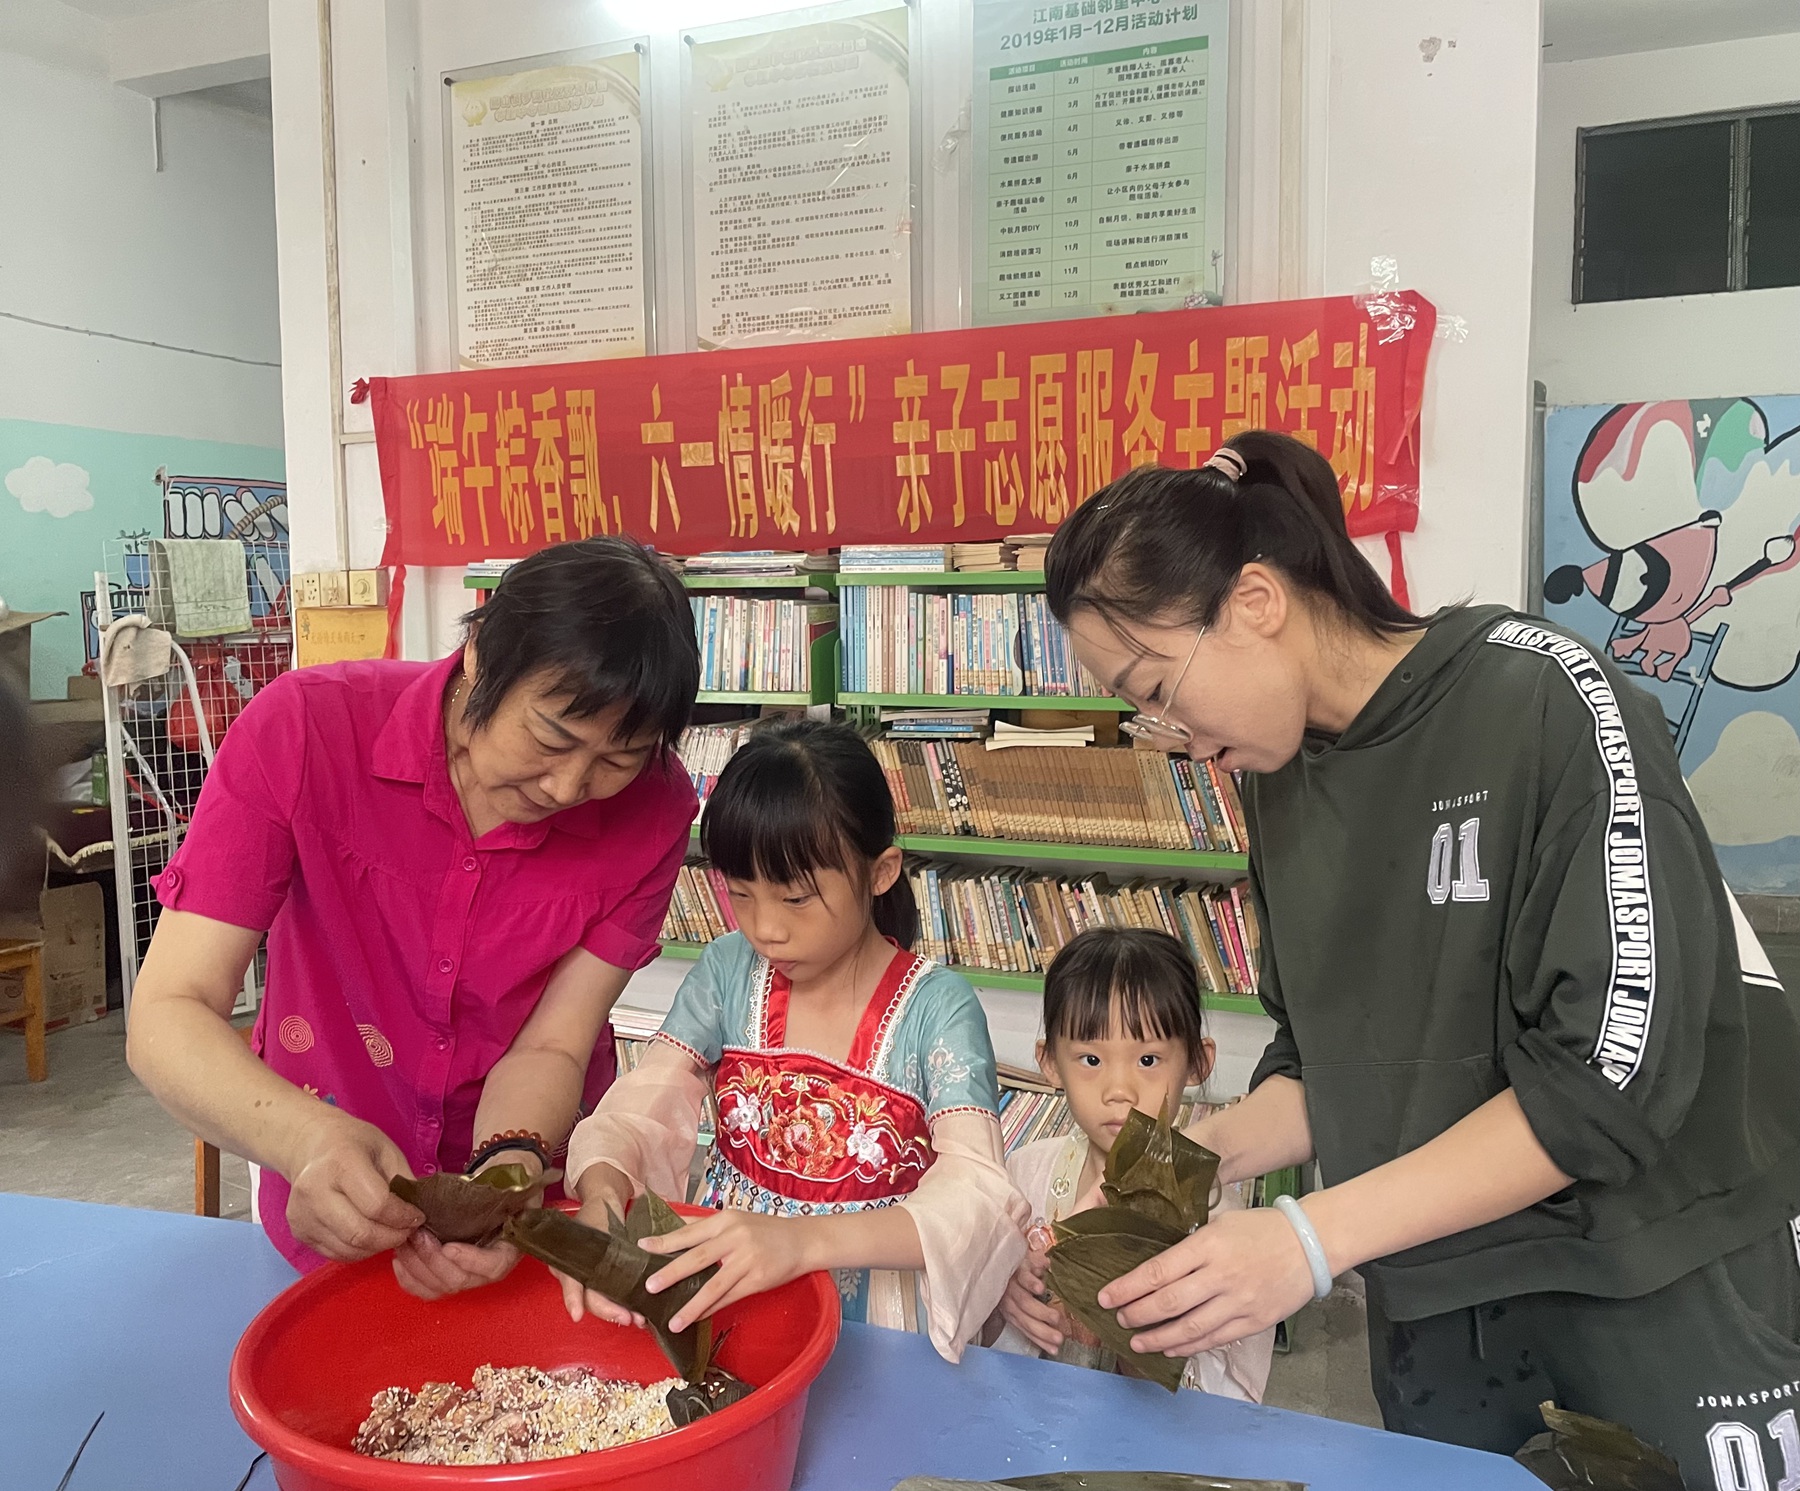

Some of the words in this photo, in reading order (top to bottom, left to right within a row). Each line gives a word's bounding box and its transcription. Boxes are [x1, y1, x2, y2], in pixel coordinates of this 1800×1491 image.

[1033, 0, 1161, 24] 江南基础邻里
[1068, 76, 1079, 85] 2月
[1068, 99, 1079, 109] 3月
[1068, 124, 1079, 133] 4月
[1067, 148, 1079, 157] 5月
[1067, 172, 1078, 181] 6月
[1066, 195, 1078, 205] 9月
[1064, 218, 1079, 228] 10月
[1064, 242, 1079, 252] 11月
[1064, 266, 1079, 275] 11月
[1063, 290, 1079, 299] 12月
[1580, 676, 1641, 827] JOMASPORT
[1427, 818, 1490, 905] 01
[1608, 831, 1651, 991] JOMASPORT
